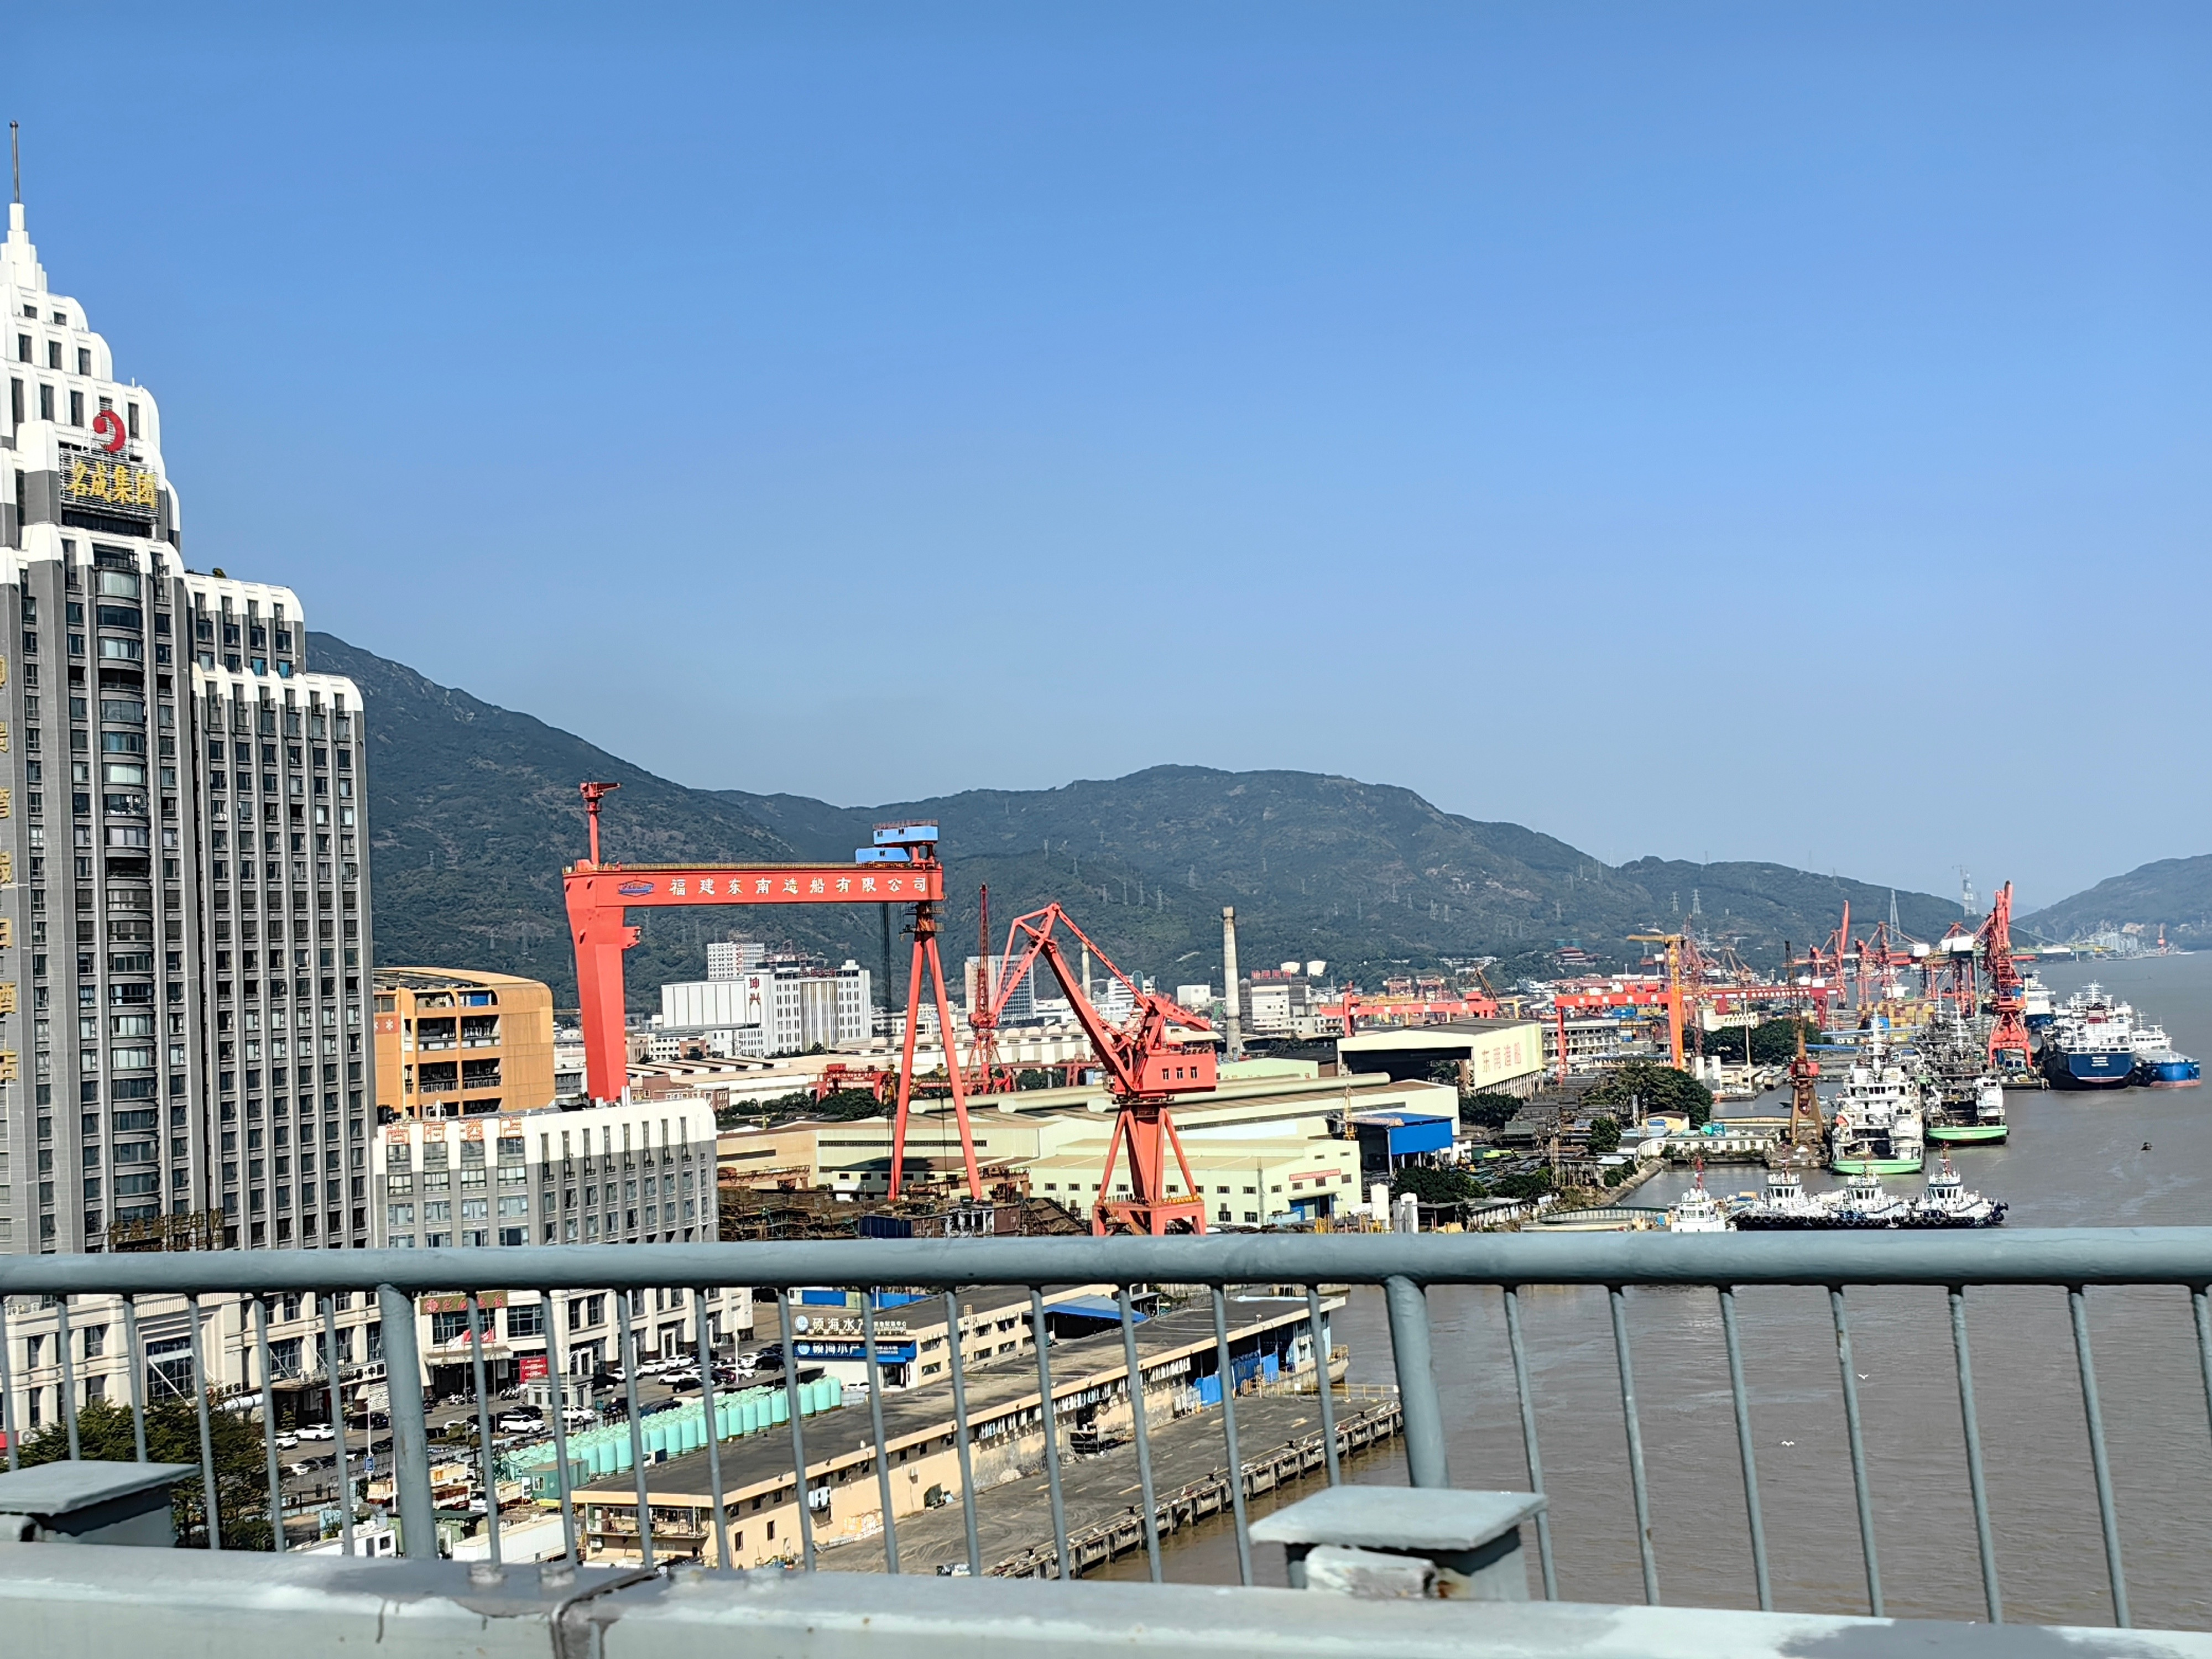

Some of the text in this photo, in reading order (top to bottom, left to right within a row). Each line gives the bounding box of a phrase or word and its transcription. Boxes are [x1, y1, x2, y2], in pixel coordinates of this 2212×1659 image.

[669, 877, 926, 896] 福建东南造船有限公司
[749, 976, 761, 1005] 坤兴
